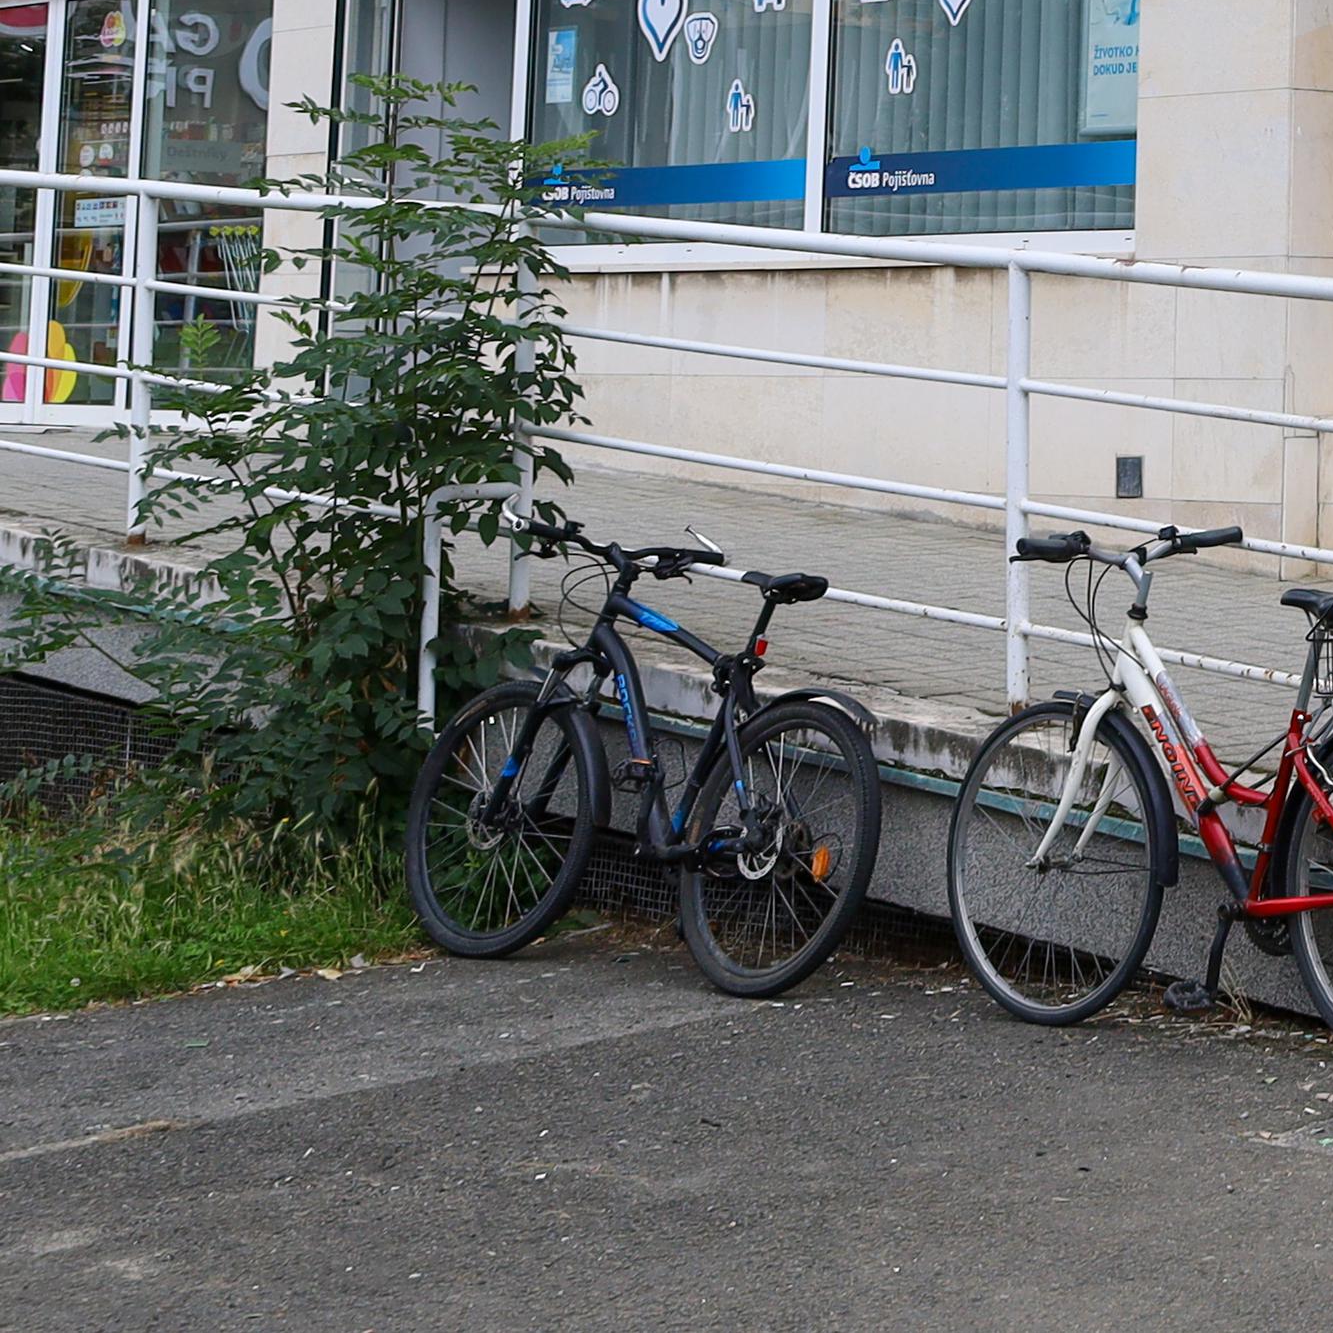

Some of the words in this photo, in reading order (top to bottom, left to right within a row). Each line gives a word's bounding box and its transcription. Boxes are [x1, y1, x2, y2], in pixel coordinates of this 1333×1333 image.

[1093, 44, 1134, 60] ŽIVOTKO
[1093, 62, 1125, 77] DOKUD
[846, 169, 880, 190] ČSOB
[882, 167, 936, 193] Pojišťovna
